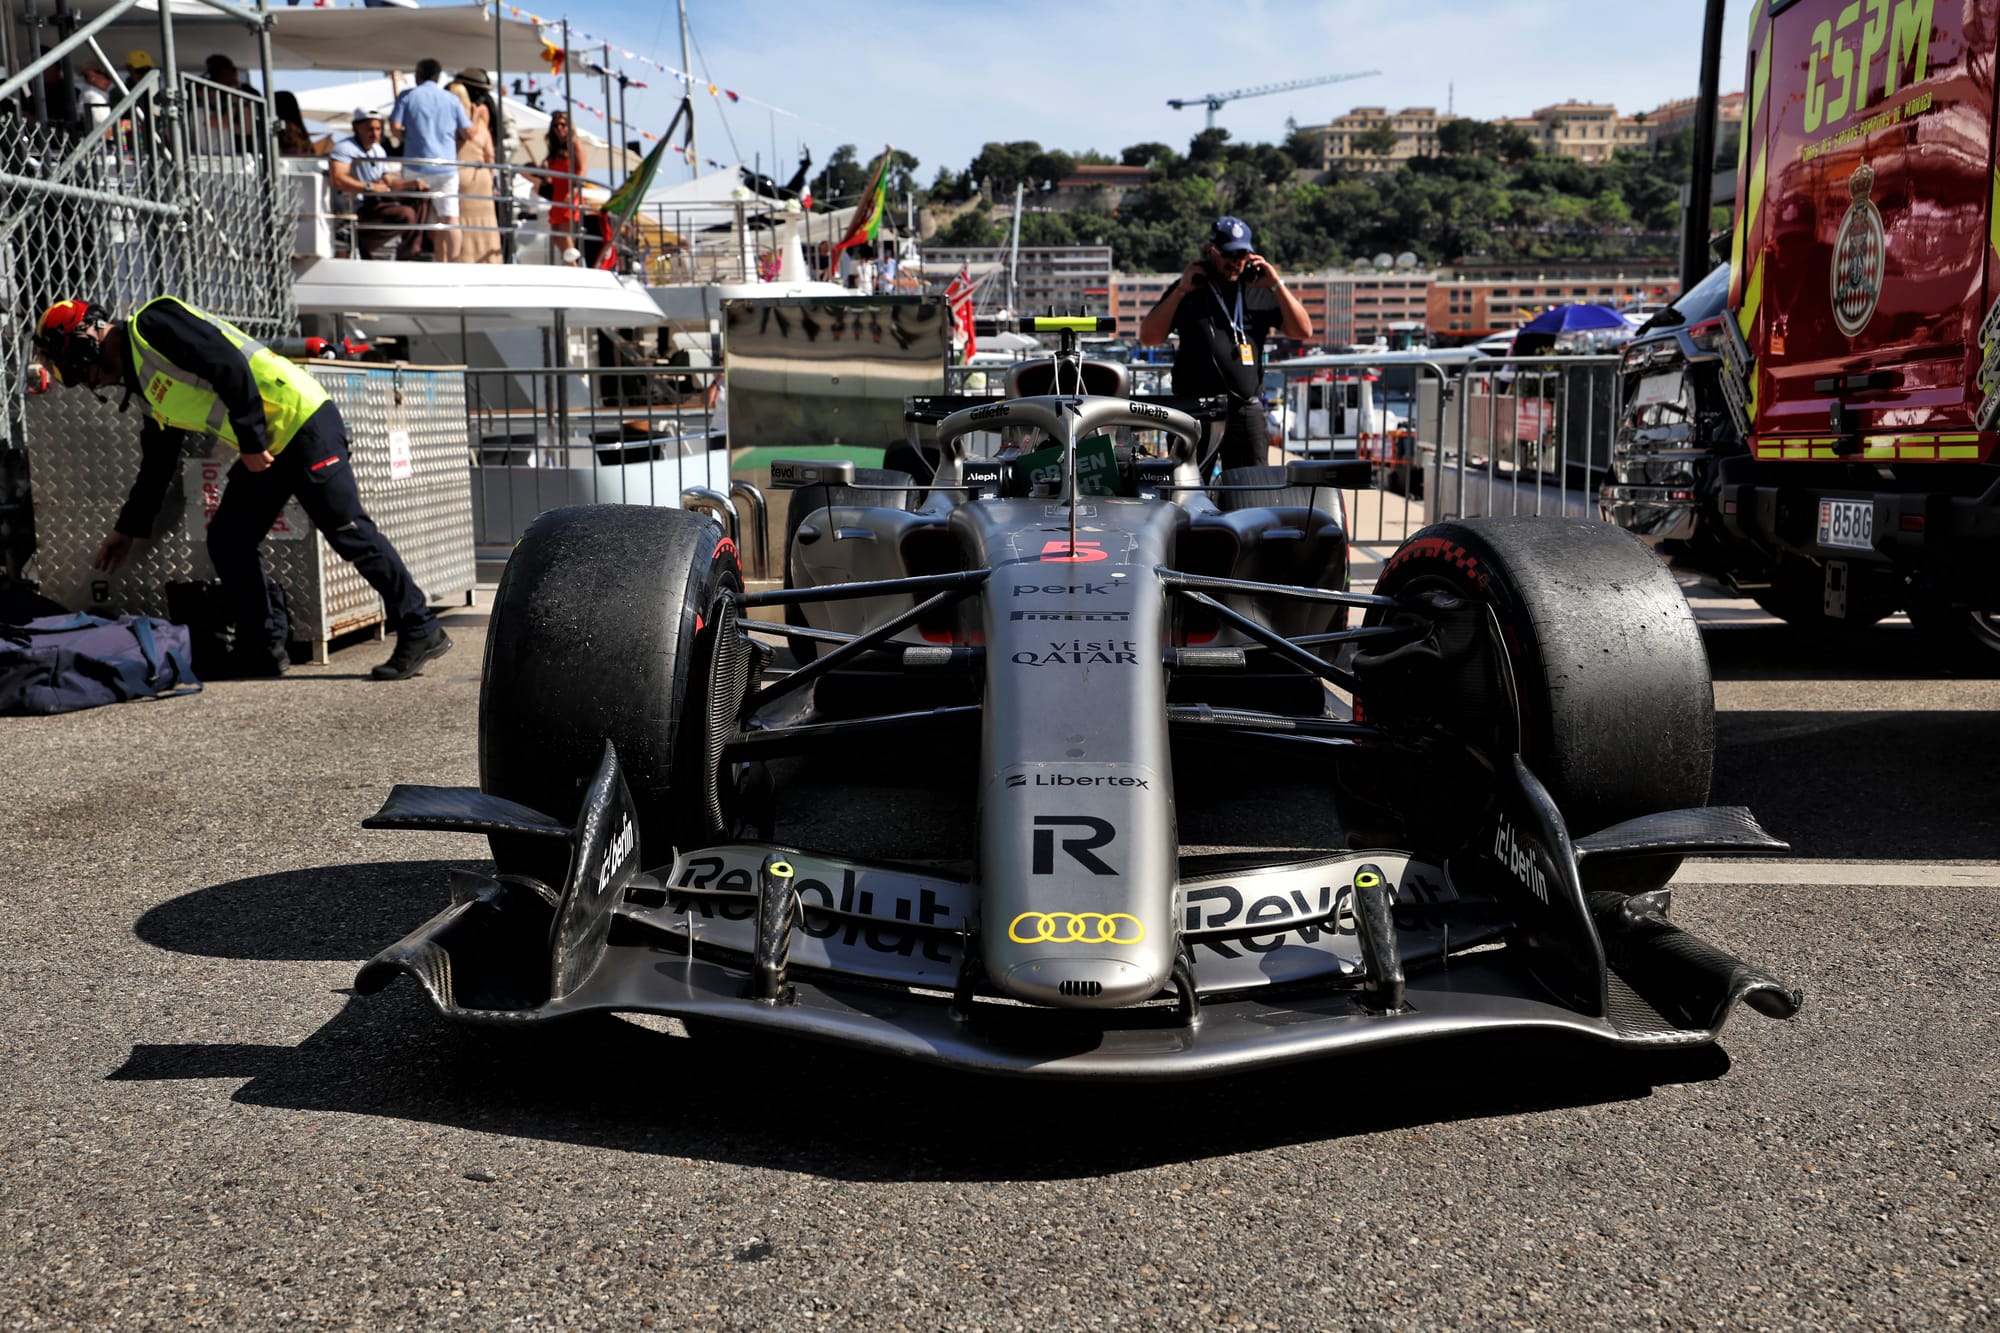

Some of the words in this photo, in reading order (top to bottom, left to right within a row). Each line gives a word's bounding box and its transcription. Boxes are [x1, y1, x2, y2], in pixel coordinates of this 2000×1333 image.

[1804, 0, 1935, 133] CSPM
[970, 404, 1010, 420] Gillette
[1129, 402, 1169, 419] Gillette
[1030, 452, 1107, 484] GREN
[967, 472, 997, 482] Aleph
[1139, 472, 1170, 482] Aleph
[1833, 504, 1872, 539] 858G
[1040, 541, 1109, 562] 5
[1010, 611, 1130, 621] PIRELLI
[1050, 640, 1137, 651] visit
[1011, 652, 1139, 666] QATAR
[1036, 774, 1149, 790] Libertex
[1033, 816, 1120, 875] R
[1510, 827, 1549, 905] berlin
[674, 857, 952, 963] Reolut
